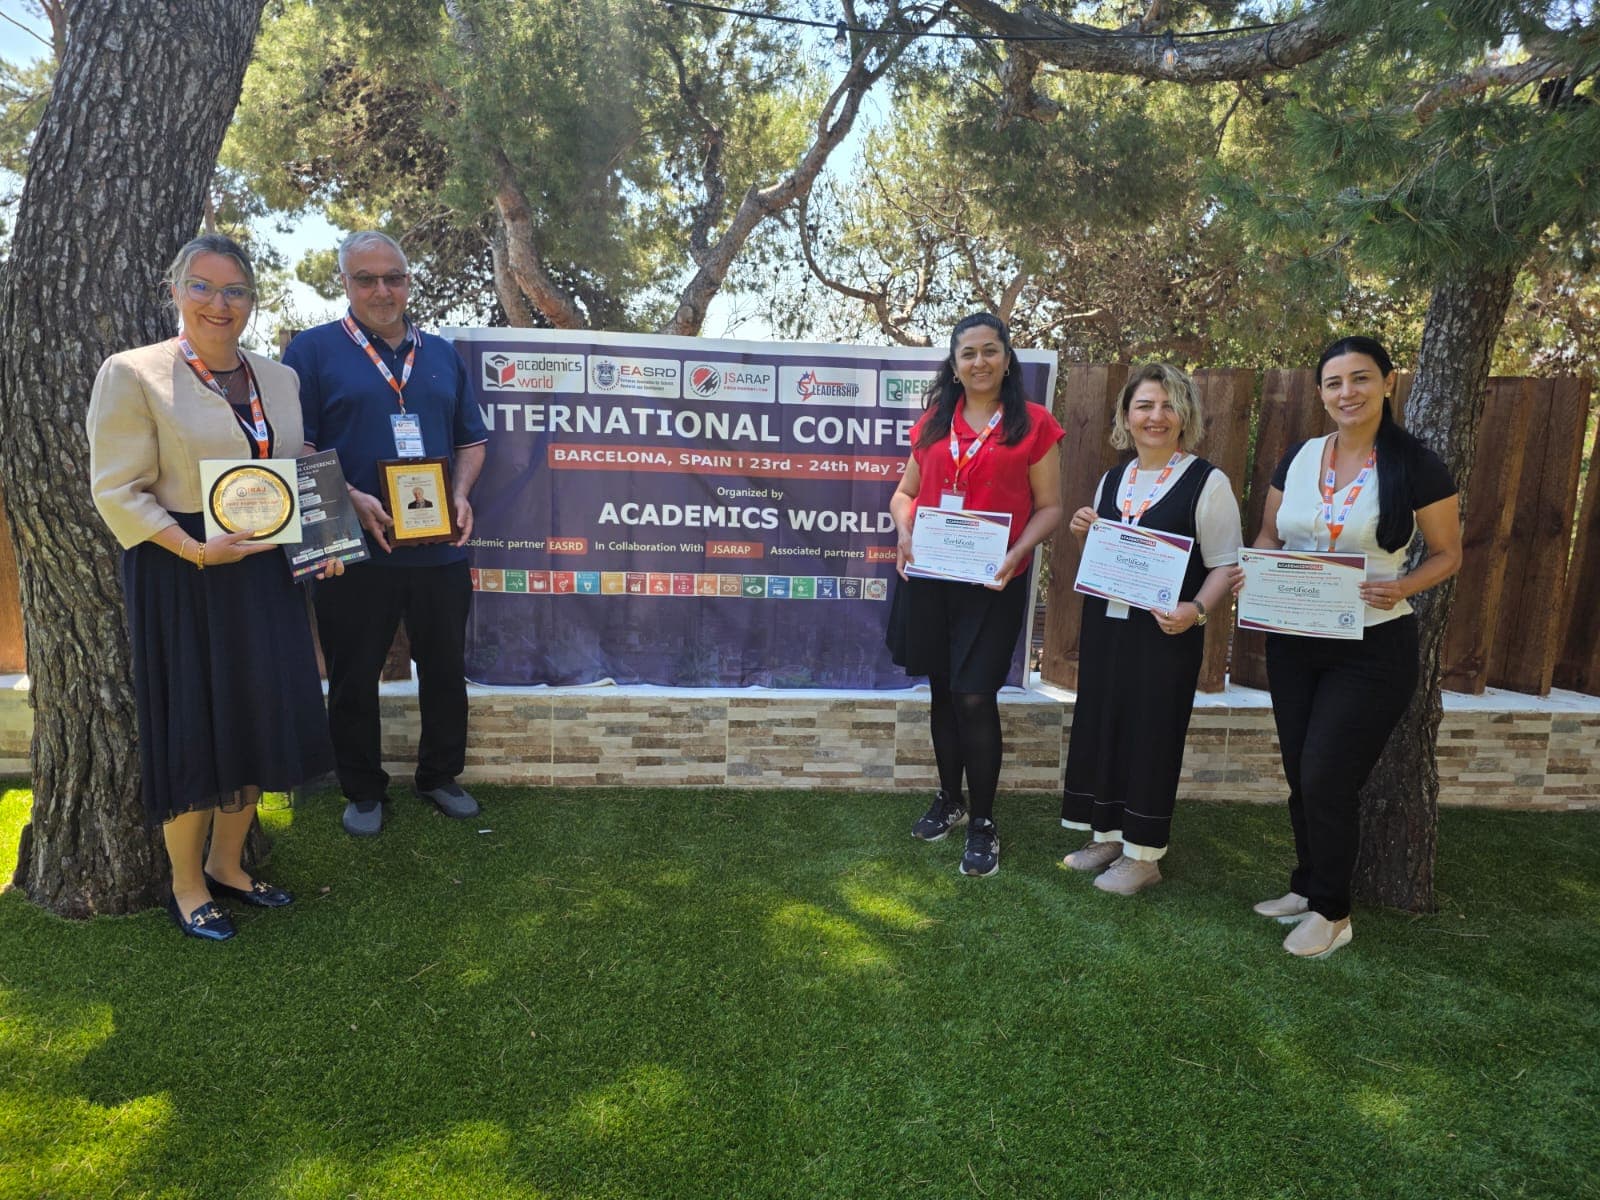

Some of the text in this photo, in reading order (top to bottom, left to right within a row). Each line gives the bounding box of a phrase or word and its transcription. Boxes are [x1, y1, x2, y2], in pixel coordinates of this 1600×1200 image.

[517, 356, 582, 372] academics
[620, 365, 677, 378] EASRD
[723, 371, 771, 385] JSARAP
[518, 375, 553, 389] world
[812, 384, 860, 397] LEADERSHIP
[554, 449, 673, 467] BARCELONA,
[680, 453, 732, 468] SPAIN
[750, 457, 791, 471] 23rd
[809, 459, 849, 473] 24th
[855, 461, 890, 476] May
[717, 486, 784, 500] Organized by
[598, 502, 779, 530] ACADEMICS
[788, 509, 896, 533] WORLD
[464, 537, 504, 548] cademic
[508, 540, 545, 550] partner
[550, 542, 584, 551] EASRD
[595, 541, 605, 551] In
[609, 541, 677, 552] Collaboration
[680, 543, 704, 553] With
[712, 544, 751, 554] JSARAP
[770, 545, 821, 556] Associated
[824, 549, 865, 559] partners
